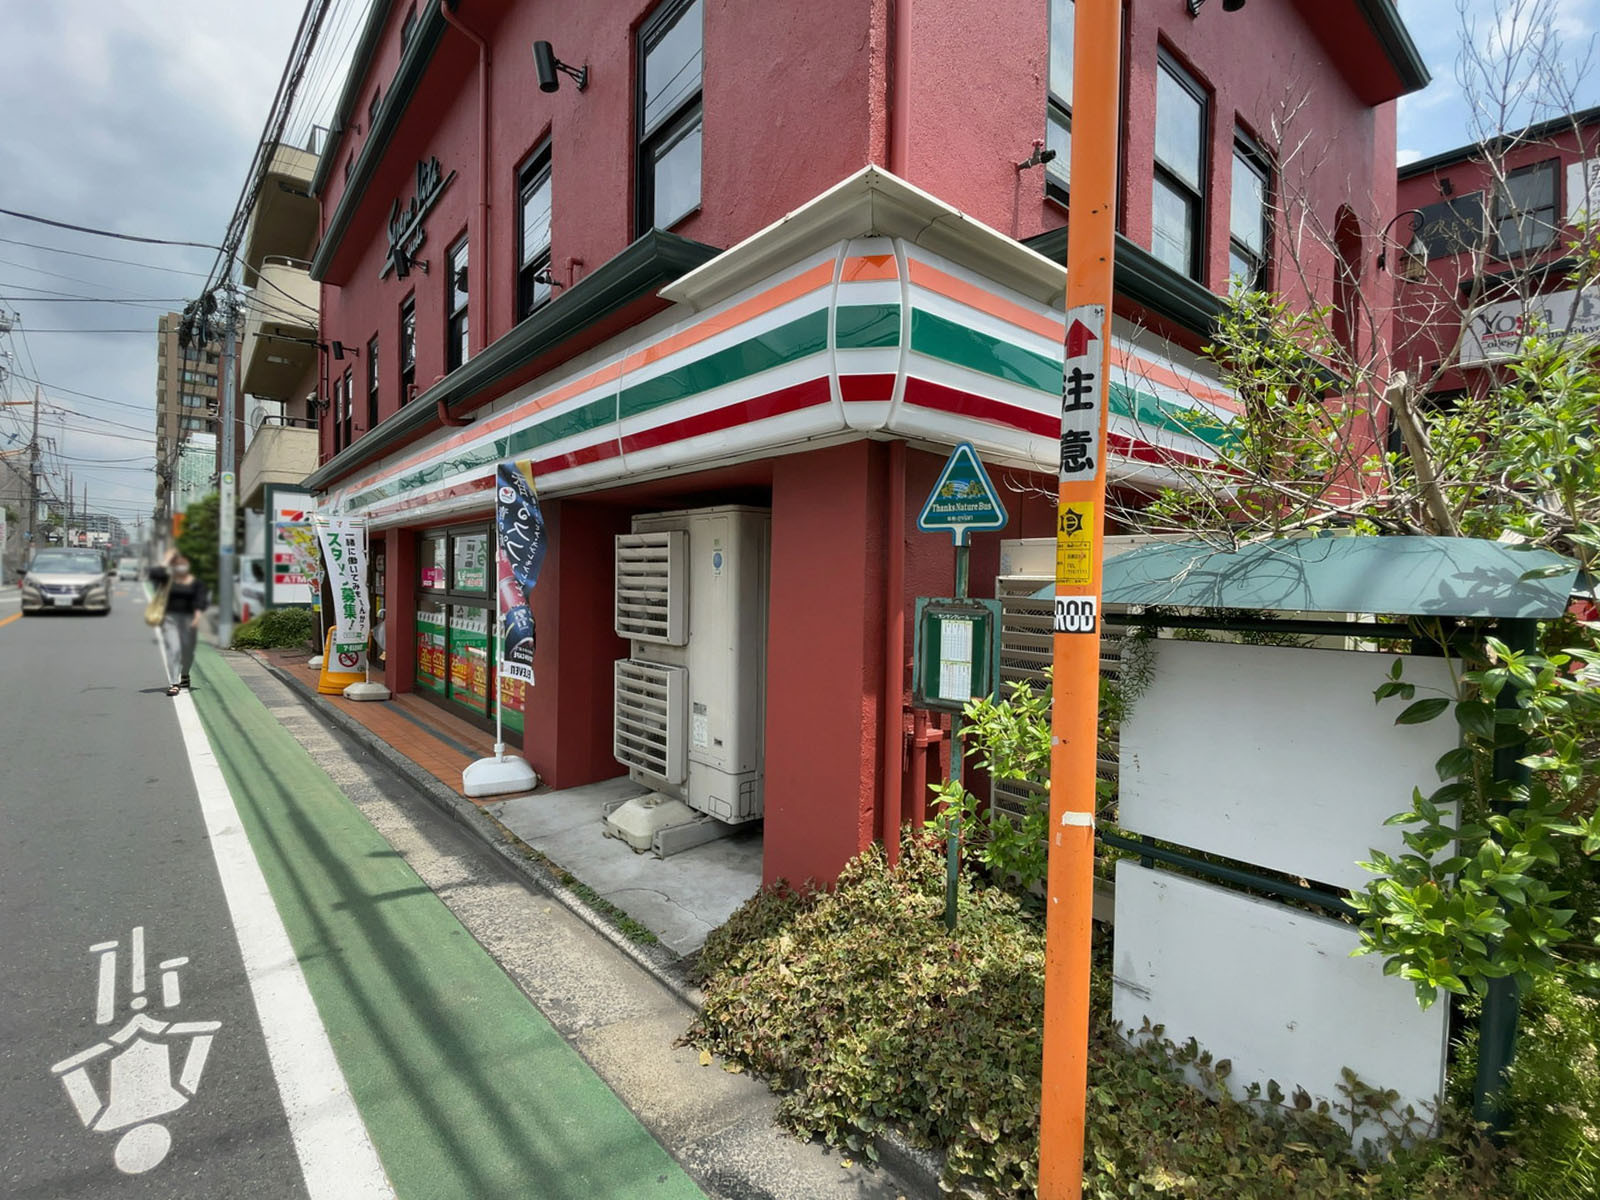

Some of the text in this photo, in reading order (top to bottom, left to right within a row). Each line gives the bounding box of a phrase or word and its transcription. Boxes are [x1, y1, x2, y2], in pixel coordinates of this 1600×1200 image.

[1060, 367, 1094, 473] 注意
[932, 500, 992, 513] Thanks Nature Bus
